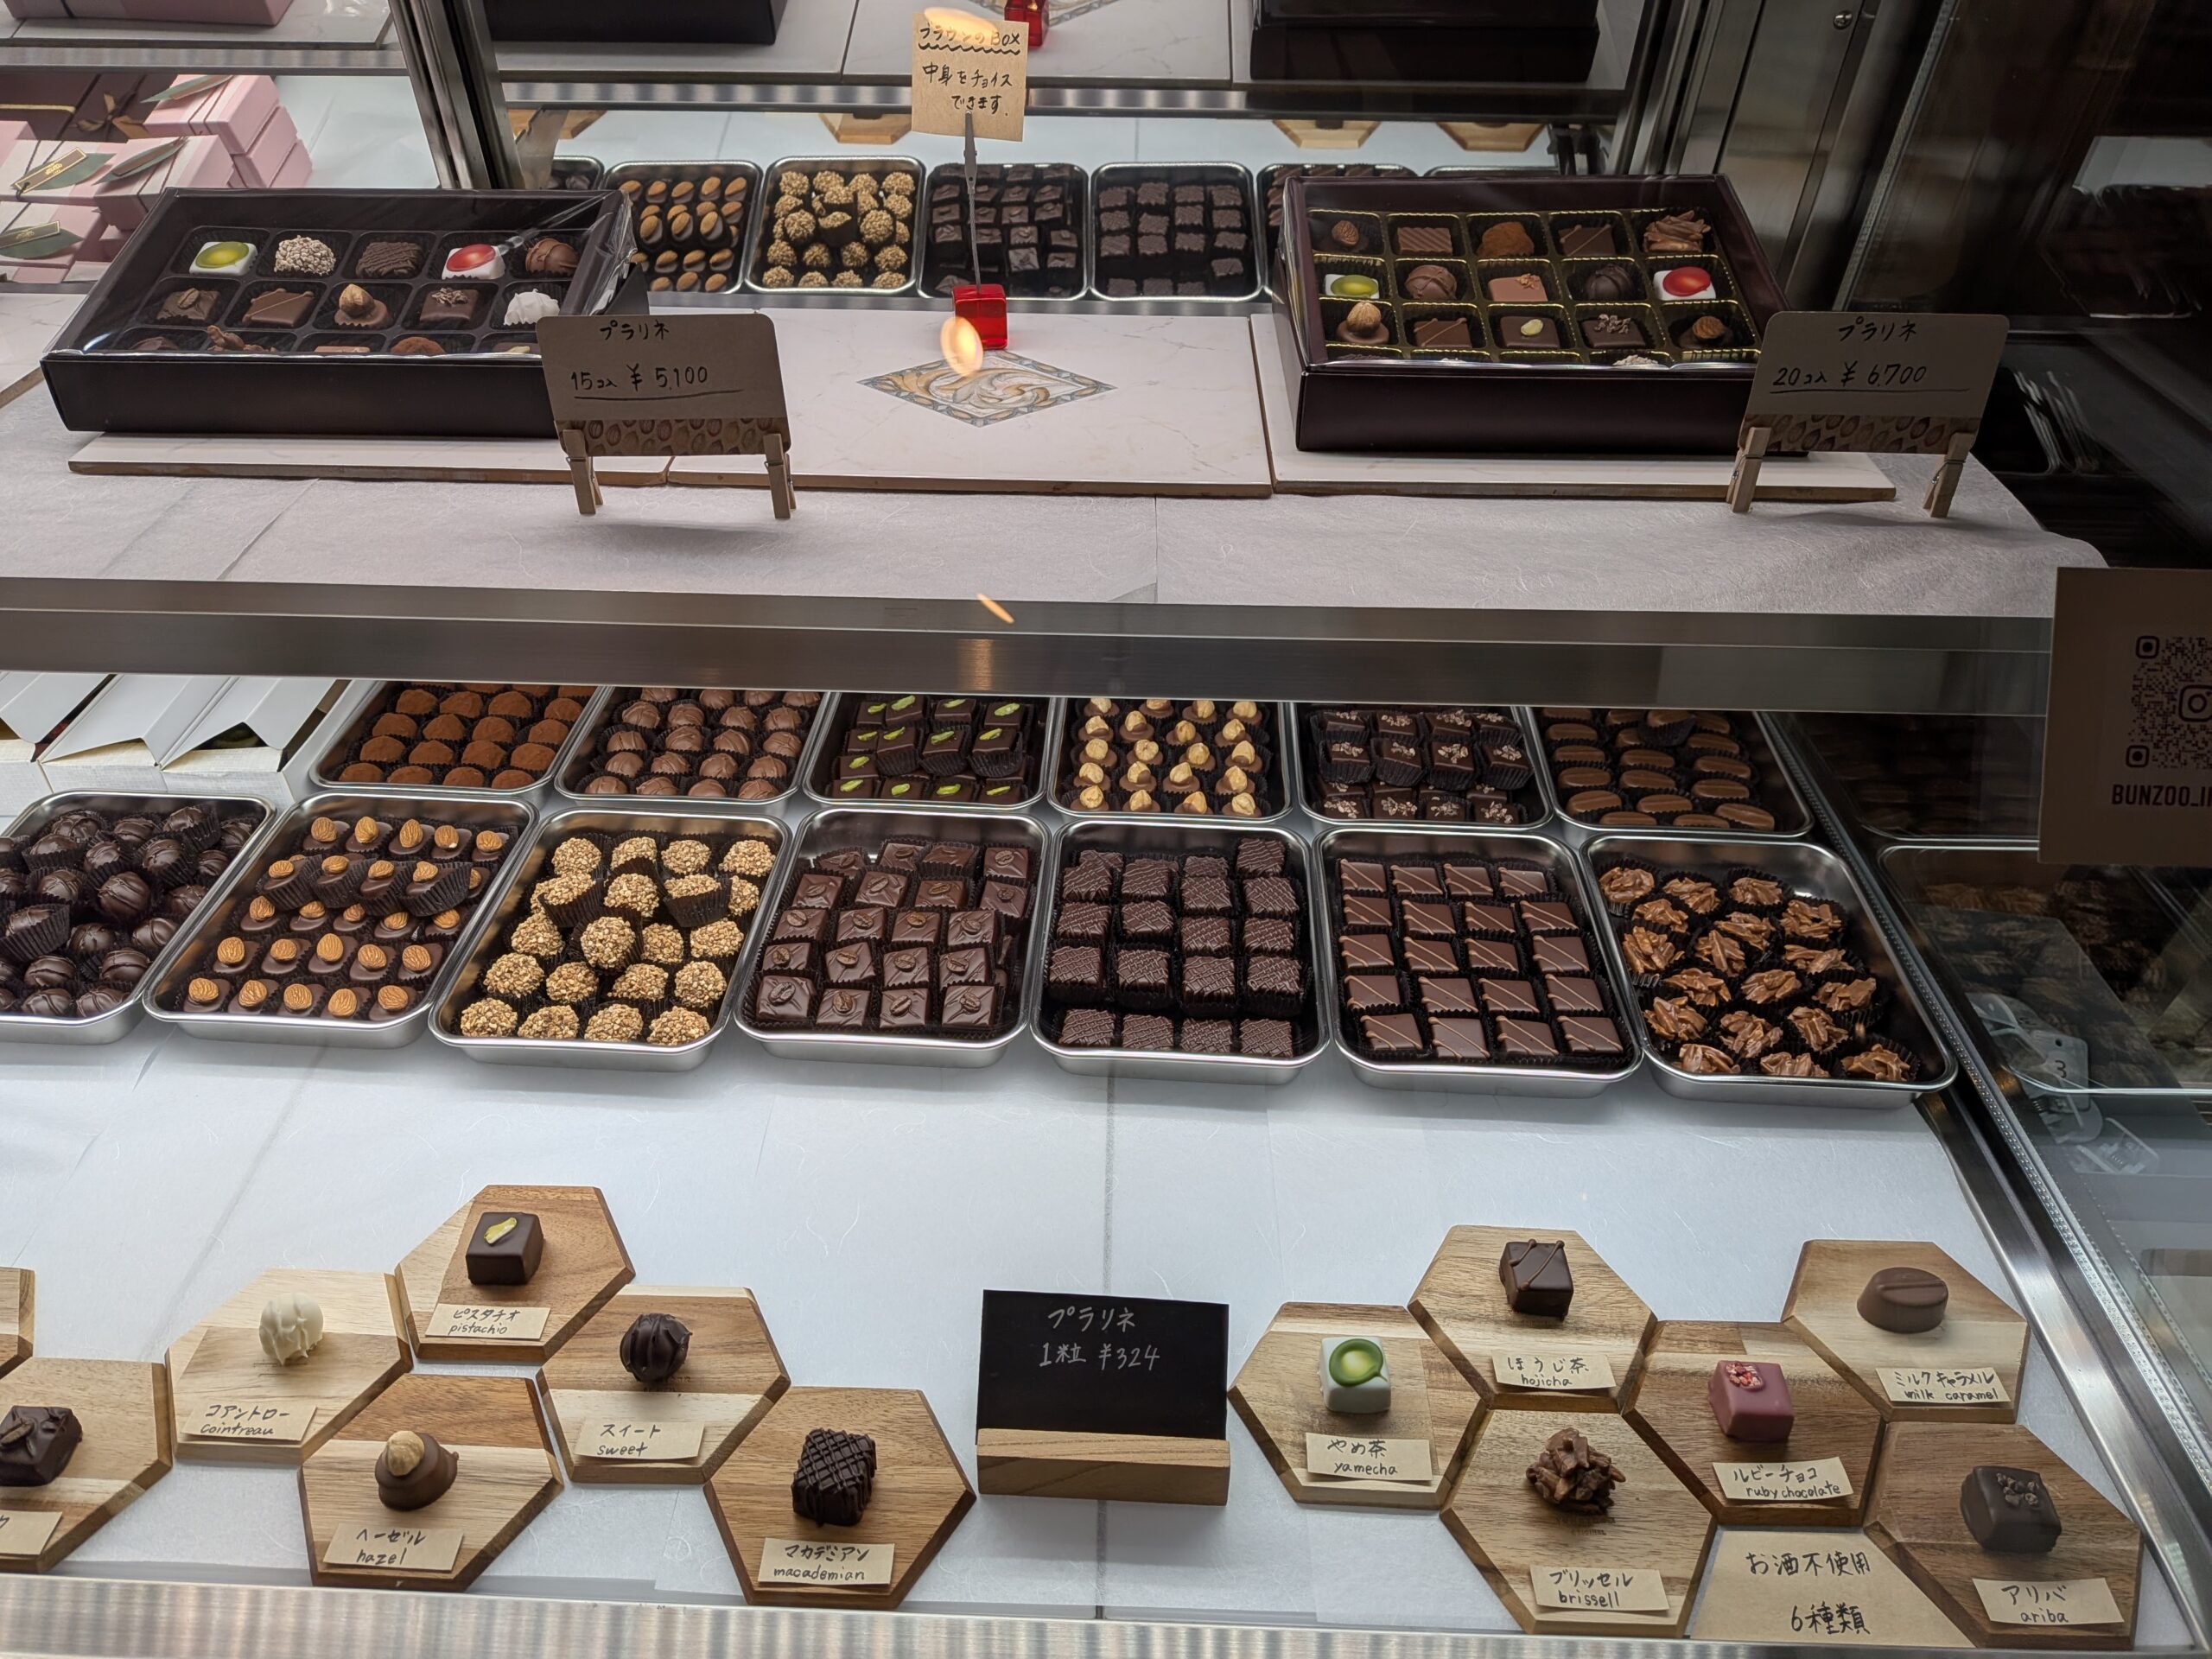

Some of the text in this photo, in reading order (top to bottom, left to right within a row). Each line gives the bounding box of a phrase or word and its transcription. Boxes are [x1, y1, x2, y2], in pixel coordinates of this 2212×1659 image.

[922, 61, 1013, 89] 中身をチョイス
[600, 320, 670, 340] プラリネ
[1839, 315, 1917, 342] プラリネ
[453, 1307, 521, 1322] ピスタチオ
[1047, 1306, 1136, 1332] プラリネ
[448, 1321, 508, 1336] pistachio
[1098, 1343, 1160, 1370] ¥324
[1507, 1357, 1590, 1375] ほうじ茶
[1521, 1373, 1573, 1387] hojicha
[1894, 1370, 1995, 1388] ミルクキャラメル
[1904, 1387, 1999, 1402] milk caramel
[205, 1404, 290, 1421] コアントロー
[600, 1423, 662, 1439] スイート
[596, 1441, 648, 1457] sweet
[1326, 1438, 1388, 1459] やめ茶
[1333, 1462, 1398, 1476] yamecha
[1733, 1464, 1818, 1484] ルビーチョコ
[1745, 1480, 1841, 1499] ruby chocolate
[355, 1528, 427, 1546] ヘーゼル
[355, 1547, 408, 1565] hazel
[784, 1544, 870, 1562] マカデミアン
[773, 1564, 865, 1580] macademian
[1745, 1550, 1871, 1577] お酒不使用
[1549, 1568, 1634, 1589] ブリッセル
[1558, 1589, 1620, 1608] brissell
[2001, 1585, 2068, 1605] アリバ
[1791, 1600, 1871, 1635] 6種類
[2020, 1607, 2069, 1623] ariba
